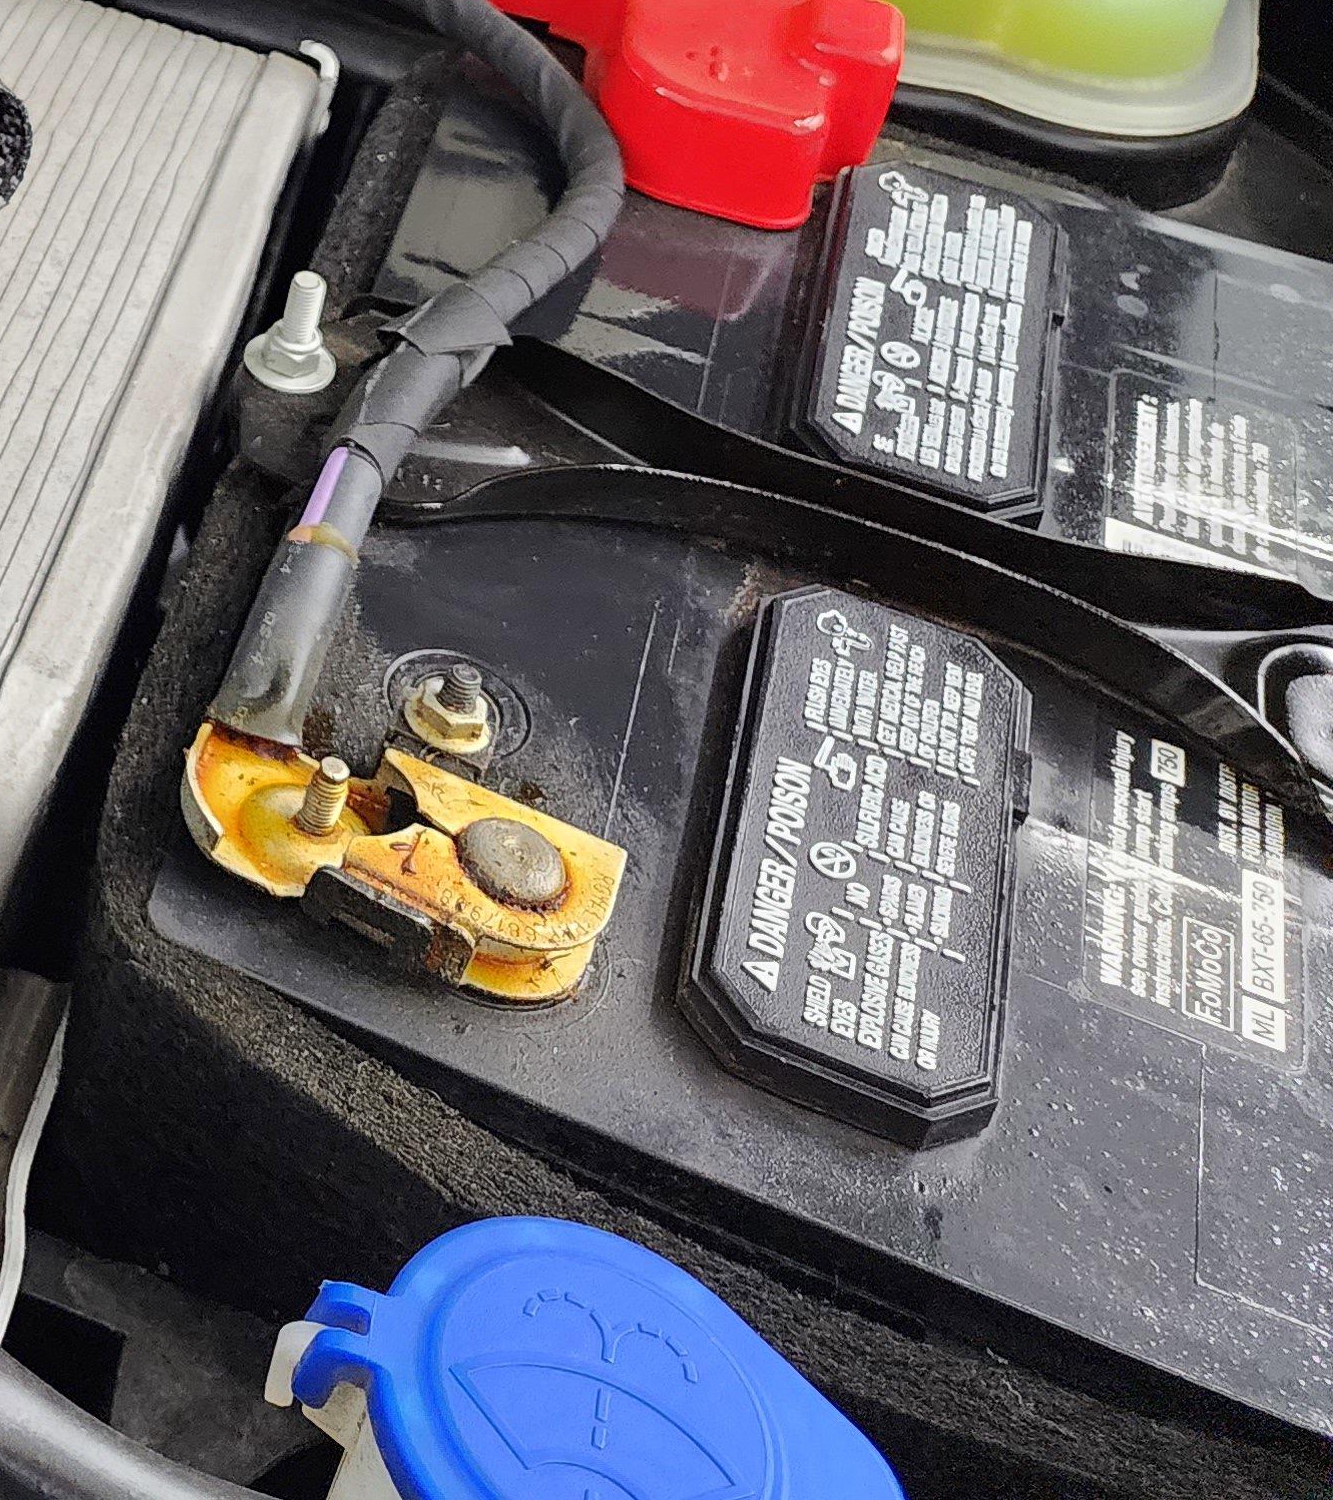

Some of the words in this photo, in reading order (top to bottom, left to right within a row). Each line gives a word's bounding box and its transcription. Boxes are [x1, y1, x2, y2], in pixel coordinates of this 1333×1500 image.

[804, 683, 827, 724] FLUSH
[864, 752, 887, 788] ACID
[1111, 728, 1134, 771] injury
[1155, 745, 1178, 779] 750
[855, 782, 884, 850] SULFURIC
[1110, 767, 1131, 830] personal
[1134, 787, 1153, 825] start
[1157, 779, 1177, 823] amps
[1216, 799, 1233, 820] BY
[1240, 781, 1259, 828] MOTOR
[748, 754, 812, 960] DANGER/POISON
[885, 831, 906, 860] CAN
[1239, 825, 1261, 865] FORD
[845, 879, 870, 909] NO
[878, 872, 902, 920] SPARKS
[903, 881, 927, 930] FLAMES
[929, 883, 953, 940] SMOKING
[865, 927, 893, 980] GASES
[1098, 881, 1126, 988] WARNING:
[1128, 920, 1149, 969] owner
[1252, 878, 1274, 993] BXT-65-750
[1127, 965, 1146, 998] see
[1193, 924, 1224, 1023] FoMoCo
[802, 971, 832, 1029] SHIELD
[828, 995, 856, 1039] EYES
[857, 972, 889, 1051] EXPLOSIVE
[891, 996, 914, 1037] CAUSE
[1251, 1003, 1275, 1042] ML
[889, 1032, 910, 1061] CAN
[917, 1048, 937, 1072] OR
